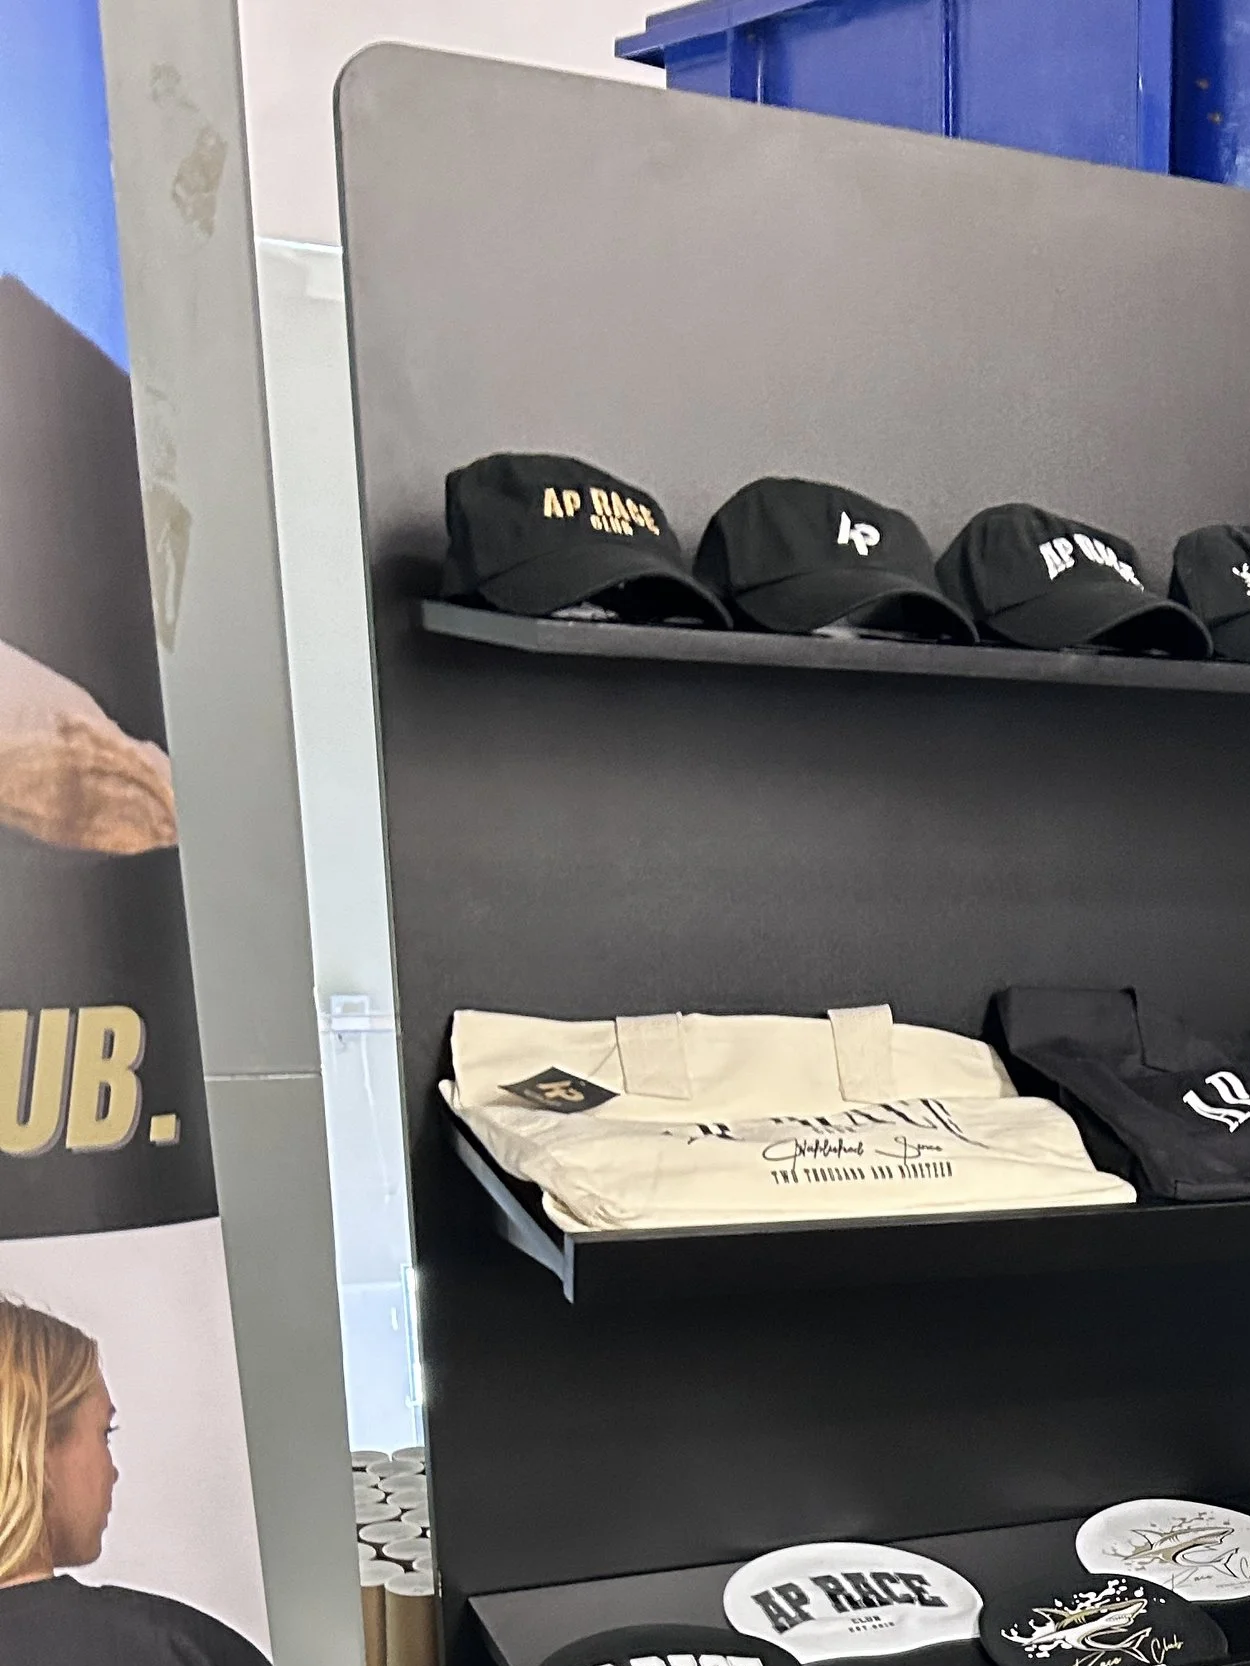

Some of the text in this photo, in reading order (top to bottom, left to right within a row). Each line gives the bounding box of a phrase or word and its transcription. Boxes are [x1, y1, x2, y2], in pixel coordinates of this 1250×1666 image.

[543, 487, 581, 518] AP
[751, 1571, 949, 1634] AP RACE
